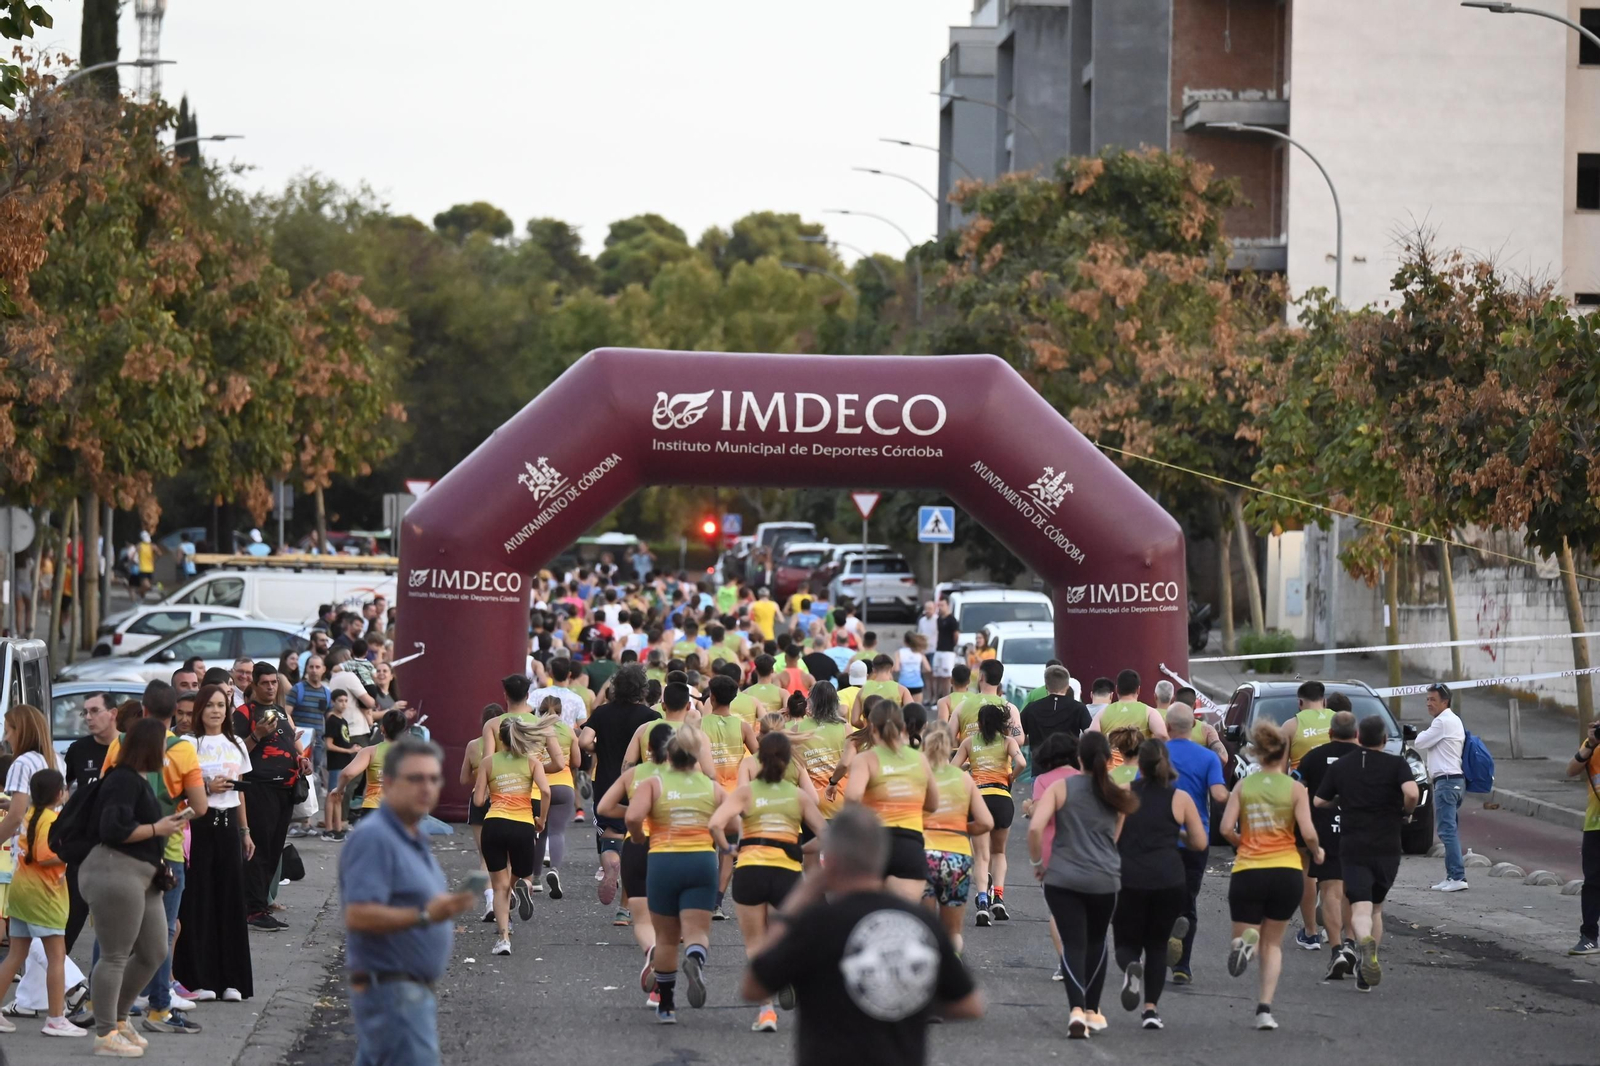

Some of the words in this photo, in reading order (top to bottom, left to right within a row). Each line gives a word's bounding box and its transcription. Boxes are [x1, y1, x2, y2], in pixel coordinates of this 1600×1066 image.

[721, 390, 947, 436] IMDECO
[652, 439, 711, 452] Instituto
[715, 441, 785, 456] Municipal
[790, 443, 808, 454] de
[812, 443, 878, 458] Deportes
[882, 445, 943, 457] Córdoba
[503, 497, 568, 554] AYUNTAMIENTO
[565, 486, 581, 502] DE
[578, 453, 622, 490] CÓRDOBA
[970, 460, 1035, 518] AYUNTAMIENTO
[1031, 513, 1047, 529] DE
[1043, 528, 1085, 565] CÓRDOBA
[431, 569, 522, 593] IMDECO
[429, 592, 460, 601] Municipal
[471, 594, 499, 602] Deportes
[1089, 582, 1179, 603] IMDECO
[1476, 677, 1520, 688] IMDECO
